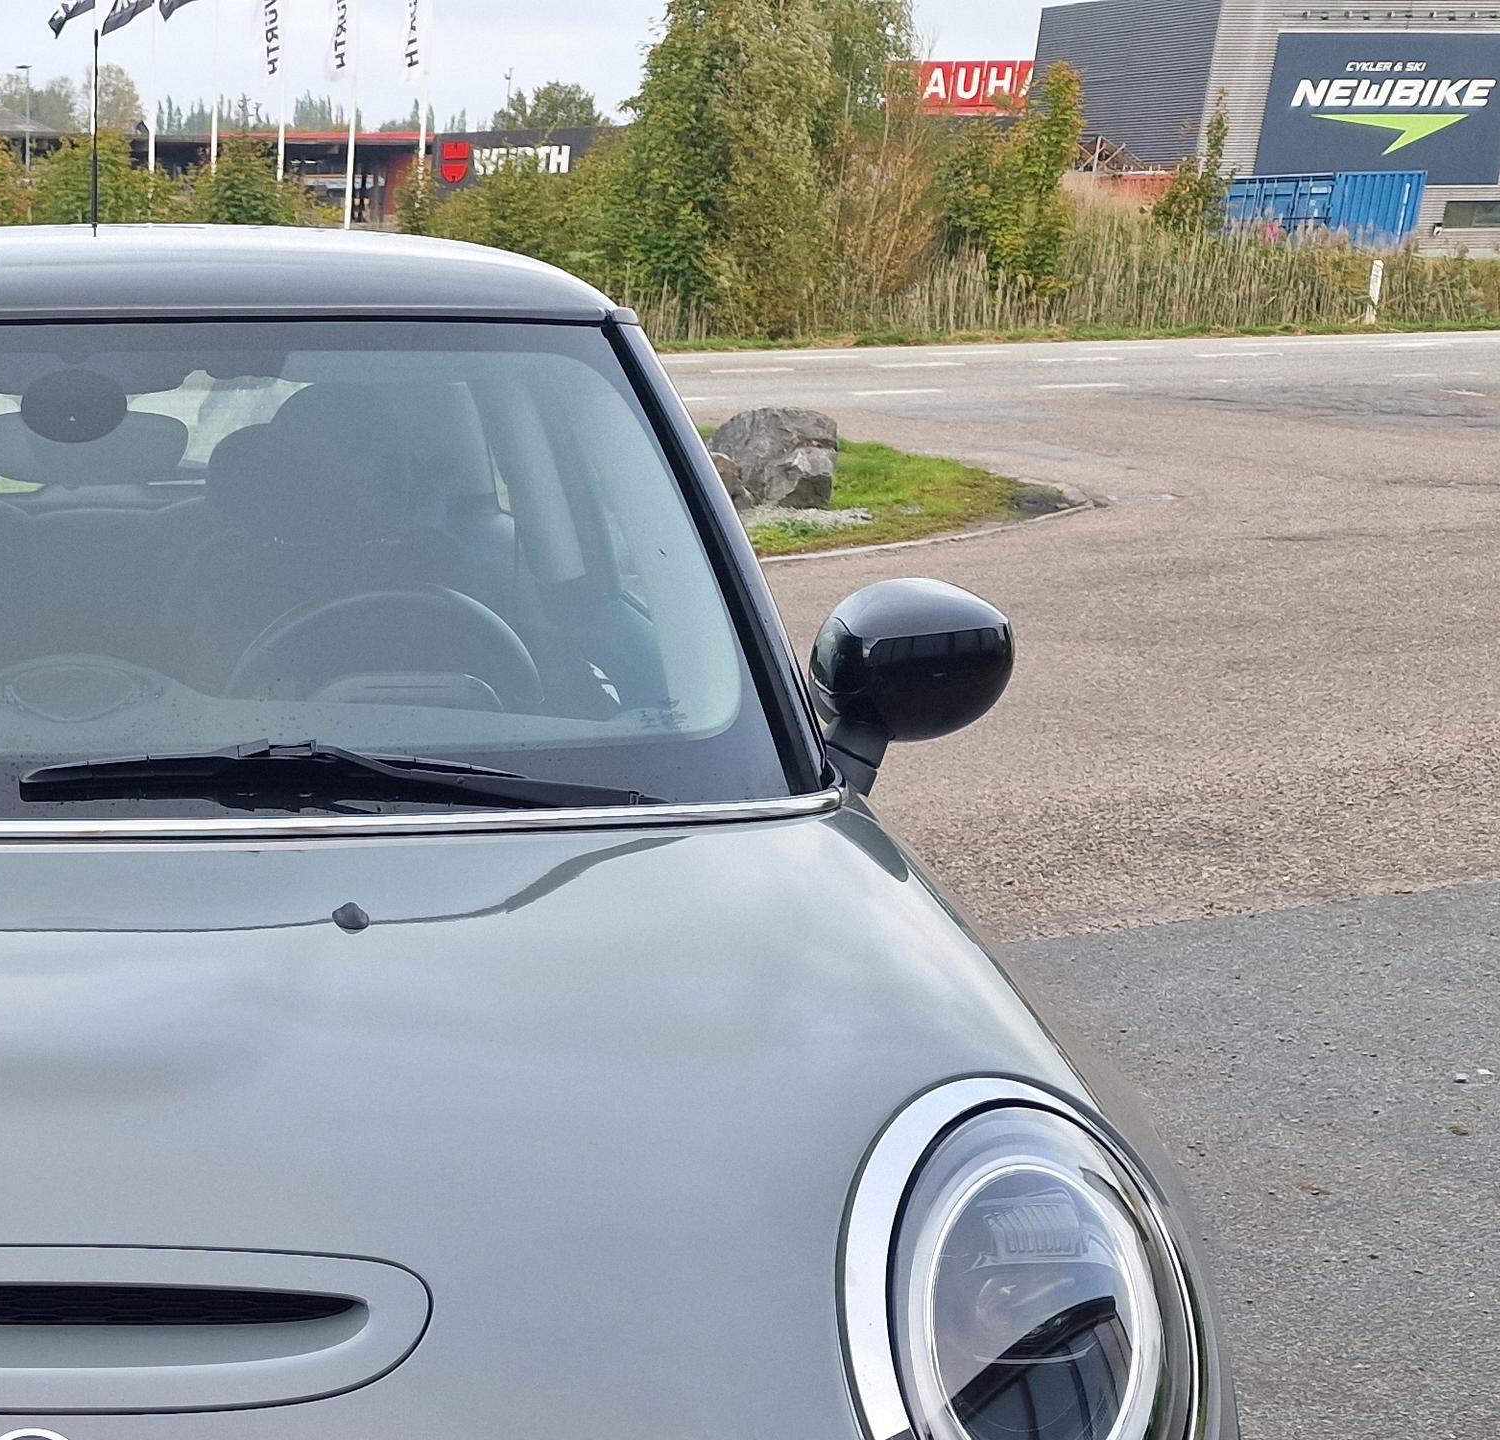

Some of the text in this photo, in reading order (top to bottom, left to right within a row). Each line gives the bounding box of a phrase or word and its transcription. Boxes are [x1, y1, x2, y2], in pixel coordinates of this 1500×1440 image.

[1345, 61, 1427, 72] CYKLER & SKI
[1290, 78, 1497, 107] NEWBIKE
